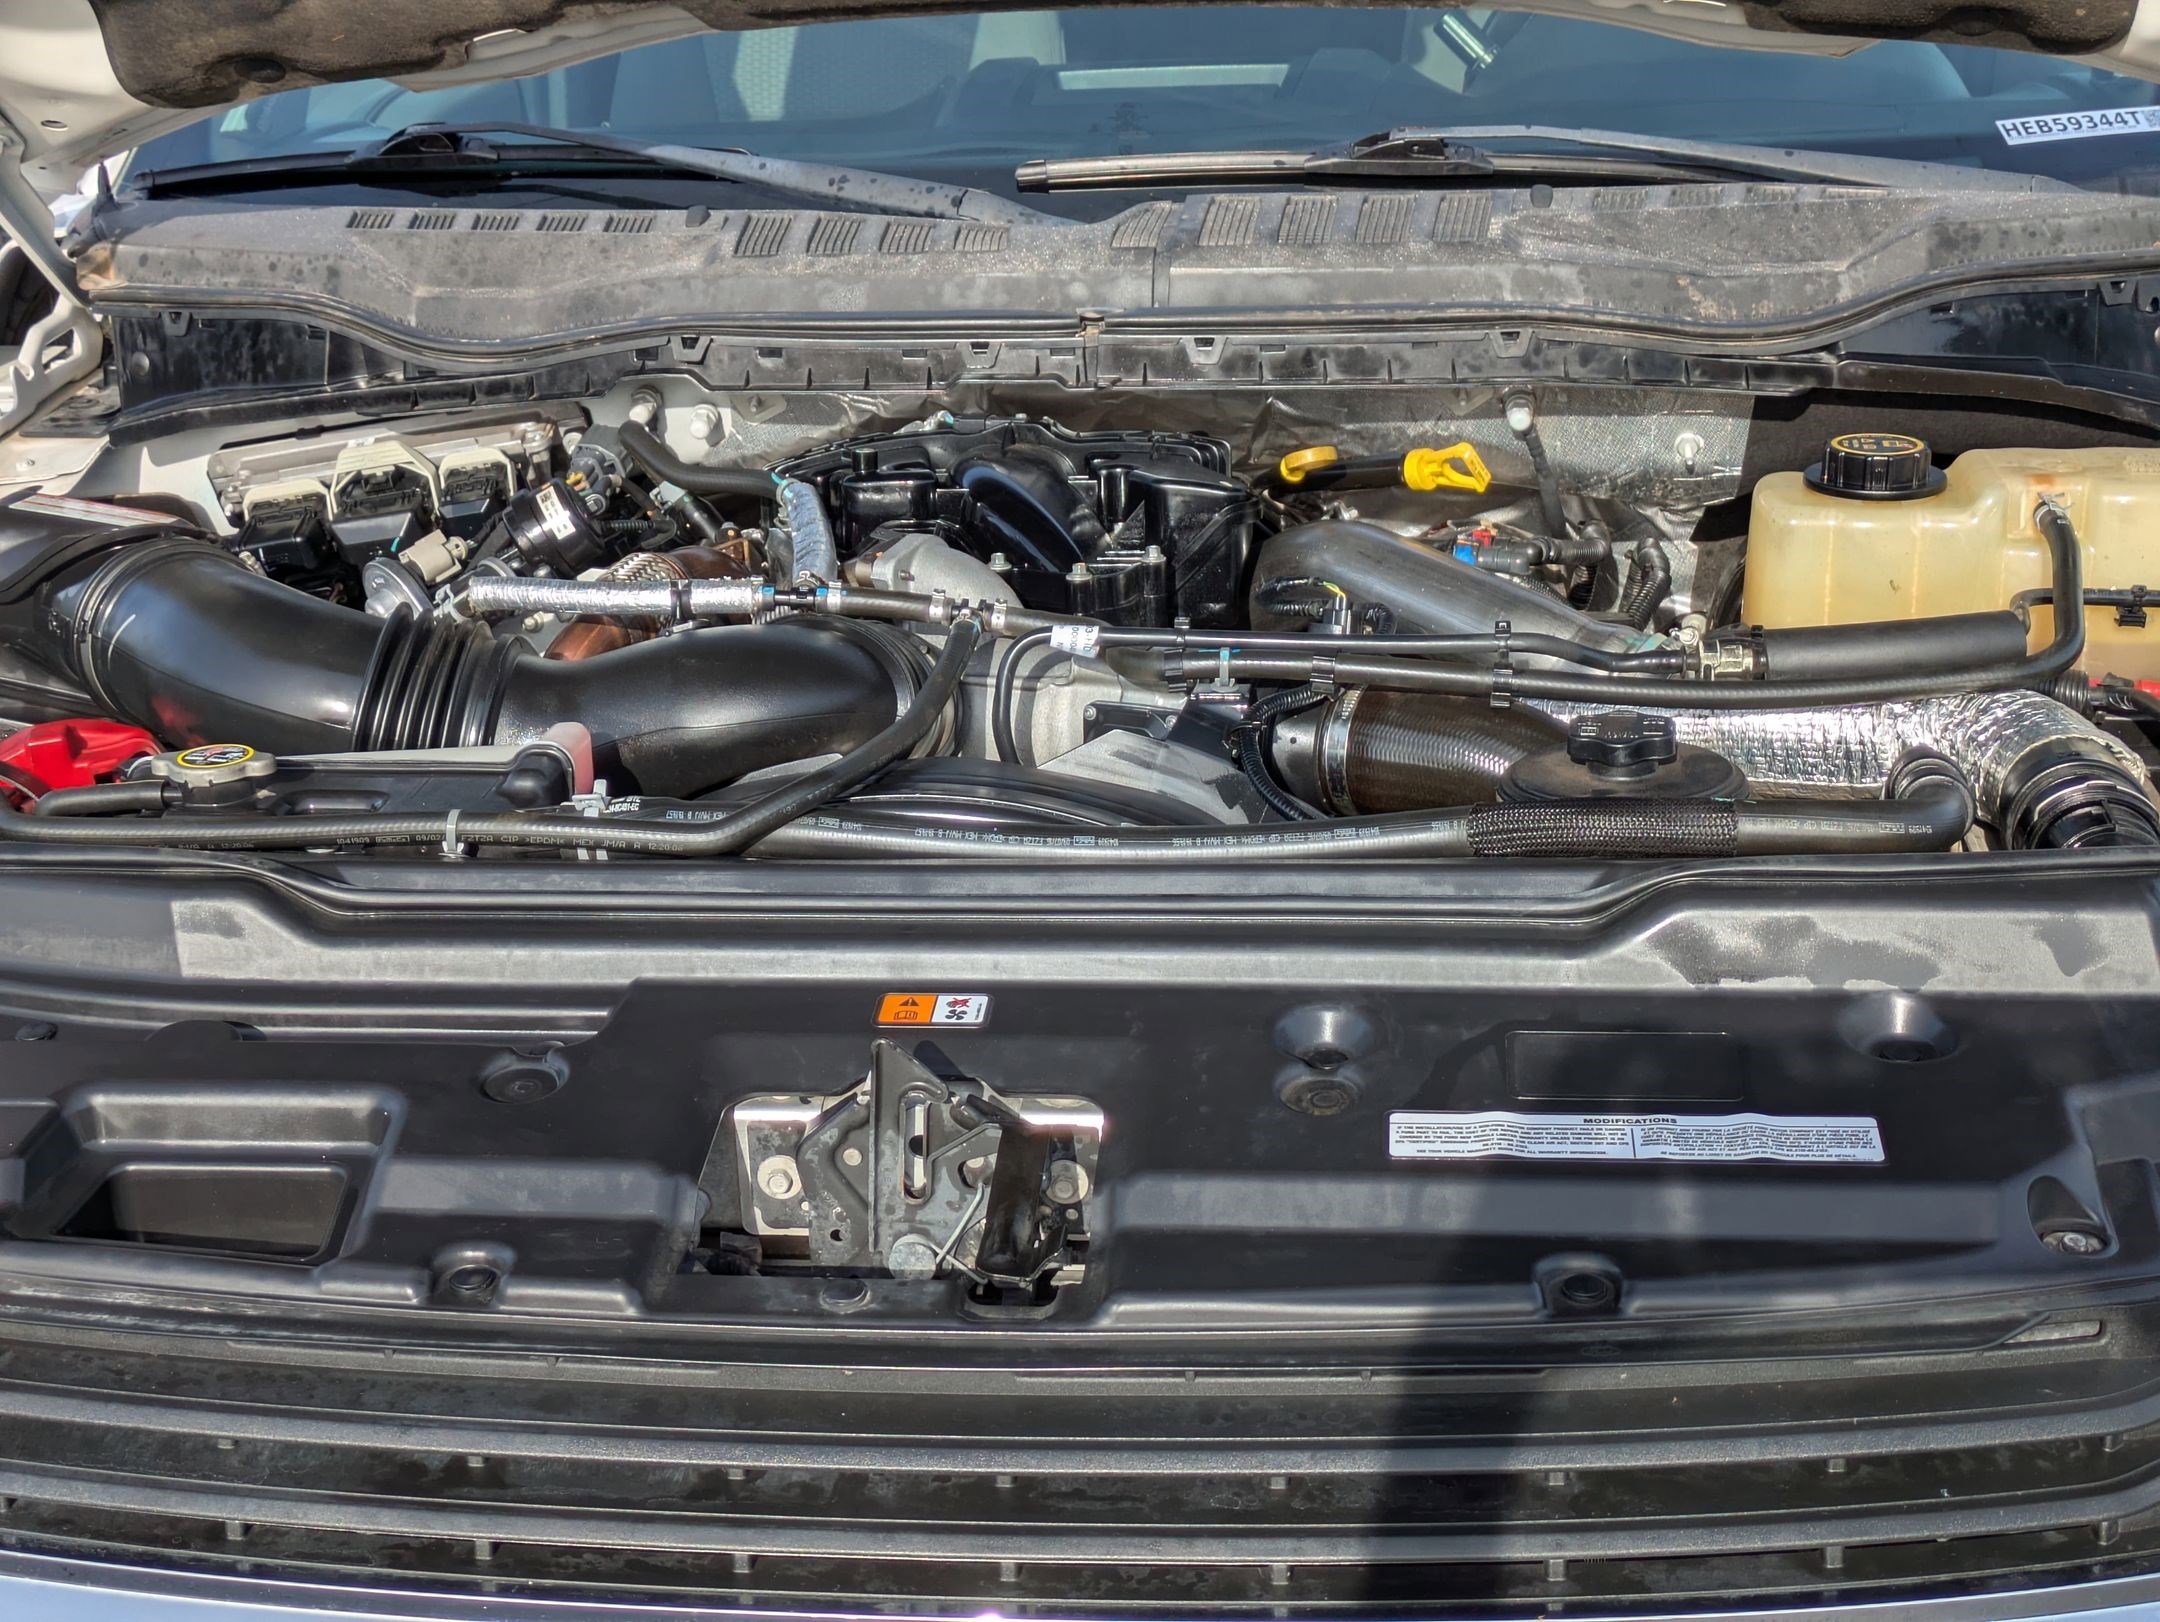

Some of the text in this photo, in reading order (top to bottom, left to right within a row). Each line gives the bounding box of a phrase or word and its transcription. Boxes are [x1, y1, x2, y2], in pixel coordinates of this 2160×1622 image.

[2001, 110, 2142, 138] HEB59344T
[501, 835, 519, 843] CIP
[573, 838, 594, 846] MEX
